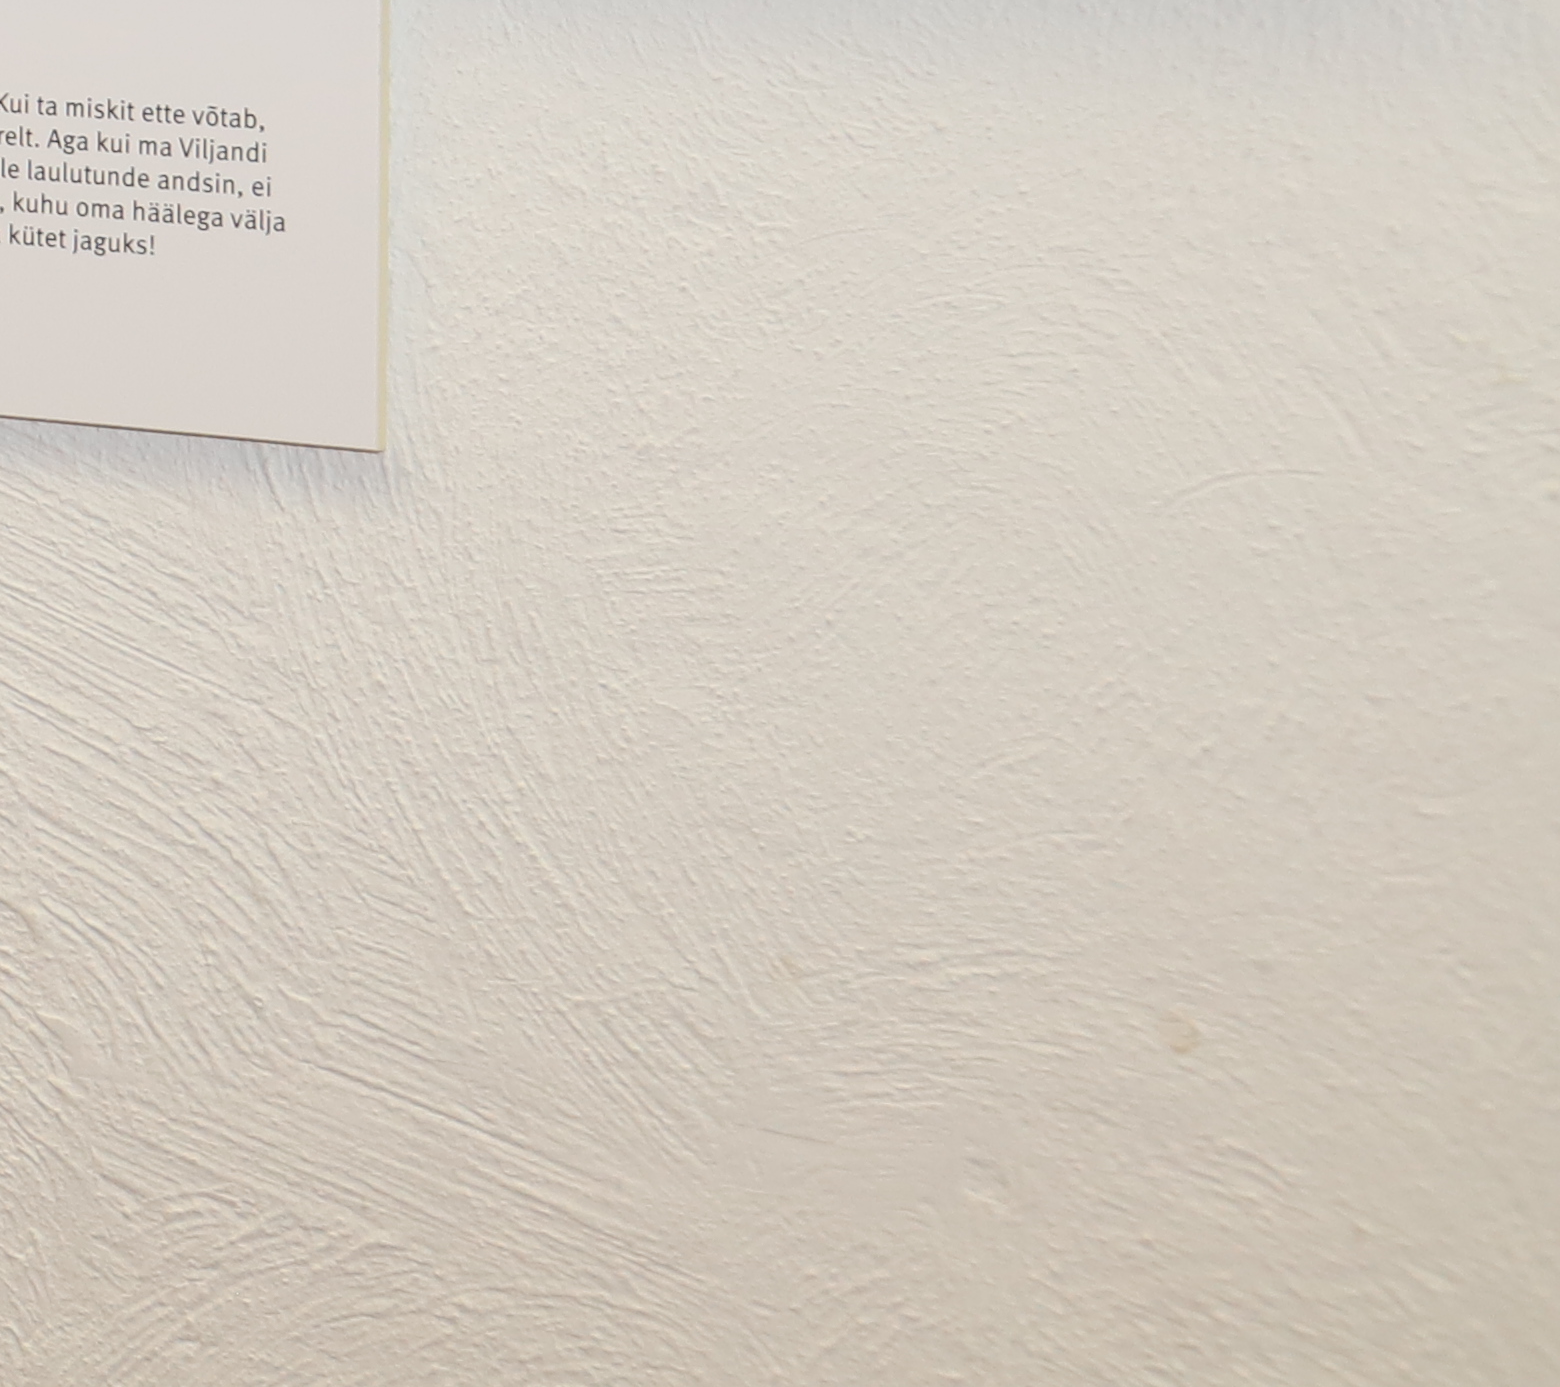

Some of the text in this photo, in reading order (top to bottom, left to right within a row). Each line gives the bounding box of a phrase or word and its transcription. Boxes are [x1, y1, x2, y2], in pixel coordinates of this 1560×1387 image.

[36, 95, 59, 117] ta
[65, 95, 136, 122] miskit
[141, 103, 187, 125] ette
[191, 104, 266, 133] võtab,
[46, 127, 90, 156] Aga
[96, 129, 131, 155] kui
[138, 138, 173, 158] ma
[178, 135, 268, 166] Viljandi
[27, 157, 151, 189] laulutunde
[156, 169, 244, 199] andsin,
[251, 175, 272, 198] ei
[12, 189, 69, 217] kuhu
[75, 199, 125, 221] oma
[132, 198, 224, 232] häälega
[229, 208, 286, 236] välja
[8, 222, 67, 250] kütet
[71, 227, 156, 258] jaguks!
